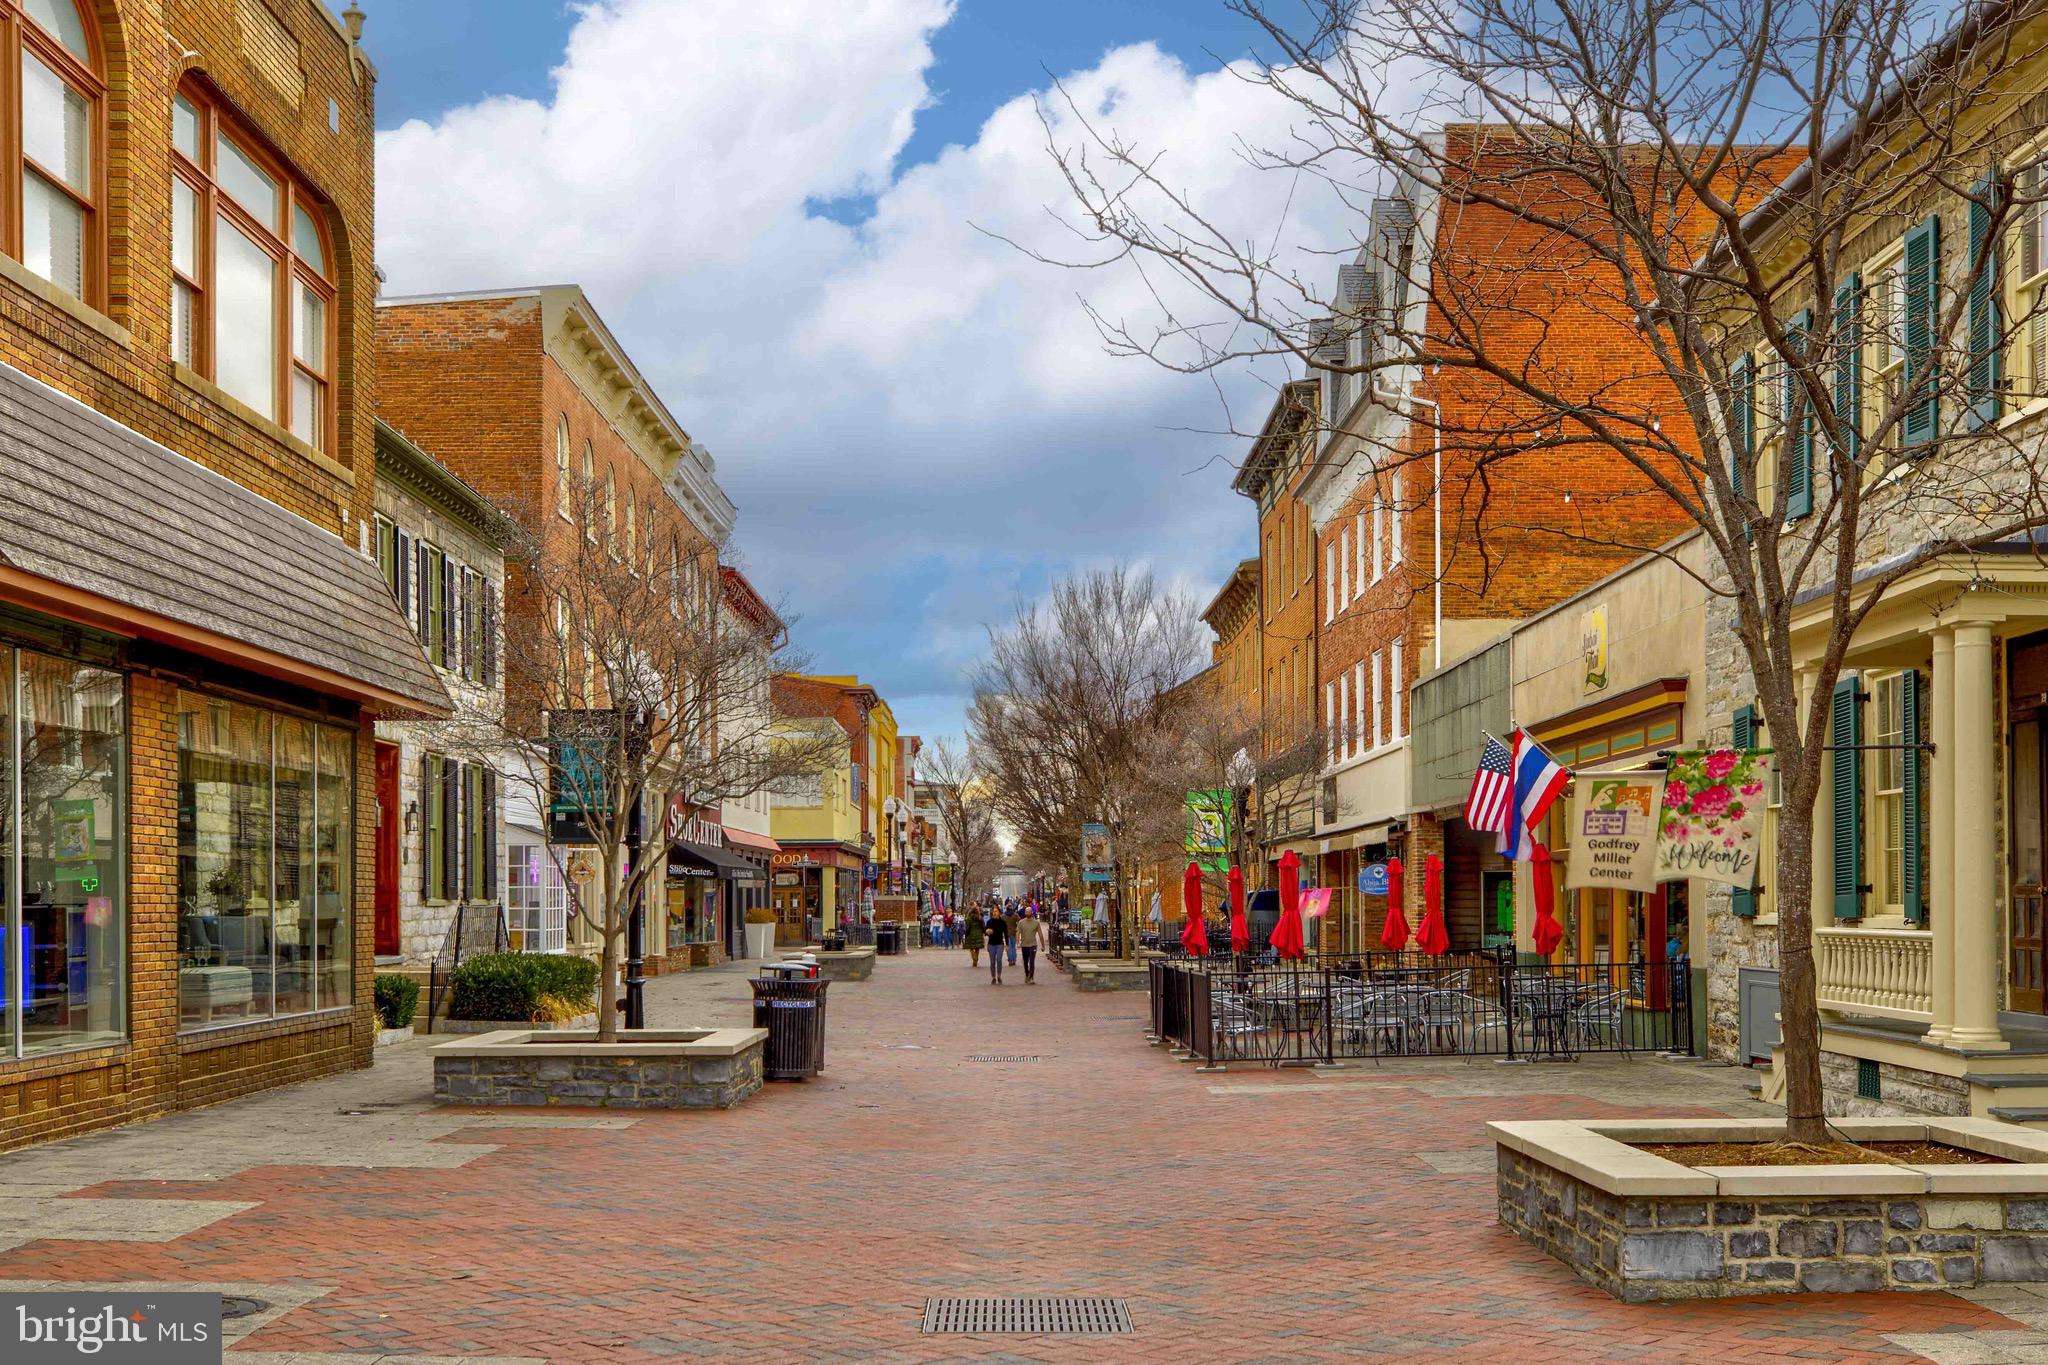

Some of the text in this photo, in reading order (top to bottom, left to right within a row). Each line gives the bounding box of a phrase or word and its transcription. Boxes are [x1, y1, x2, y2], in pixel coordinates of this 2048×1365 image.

[1588, 838, 1640, 853] Godfrey
[1594, 852, 1632, 865] Miller
[1670, 840, 1752, 874] Welcome
[1589, 867, 1633, 880] Center
